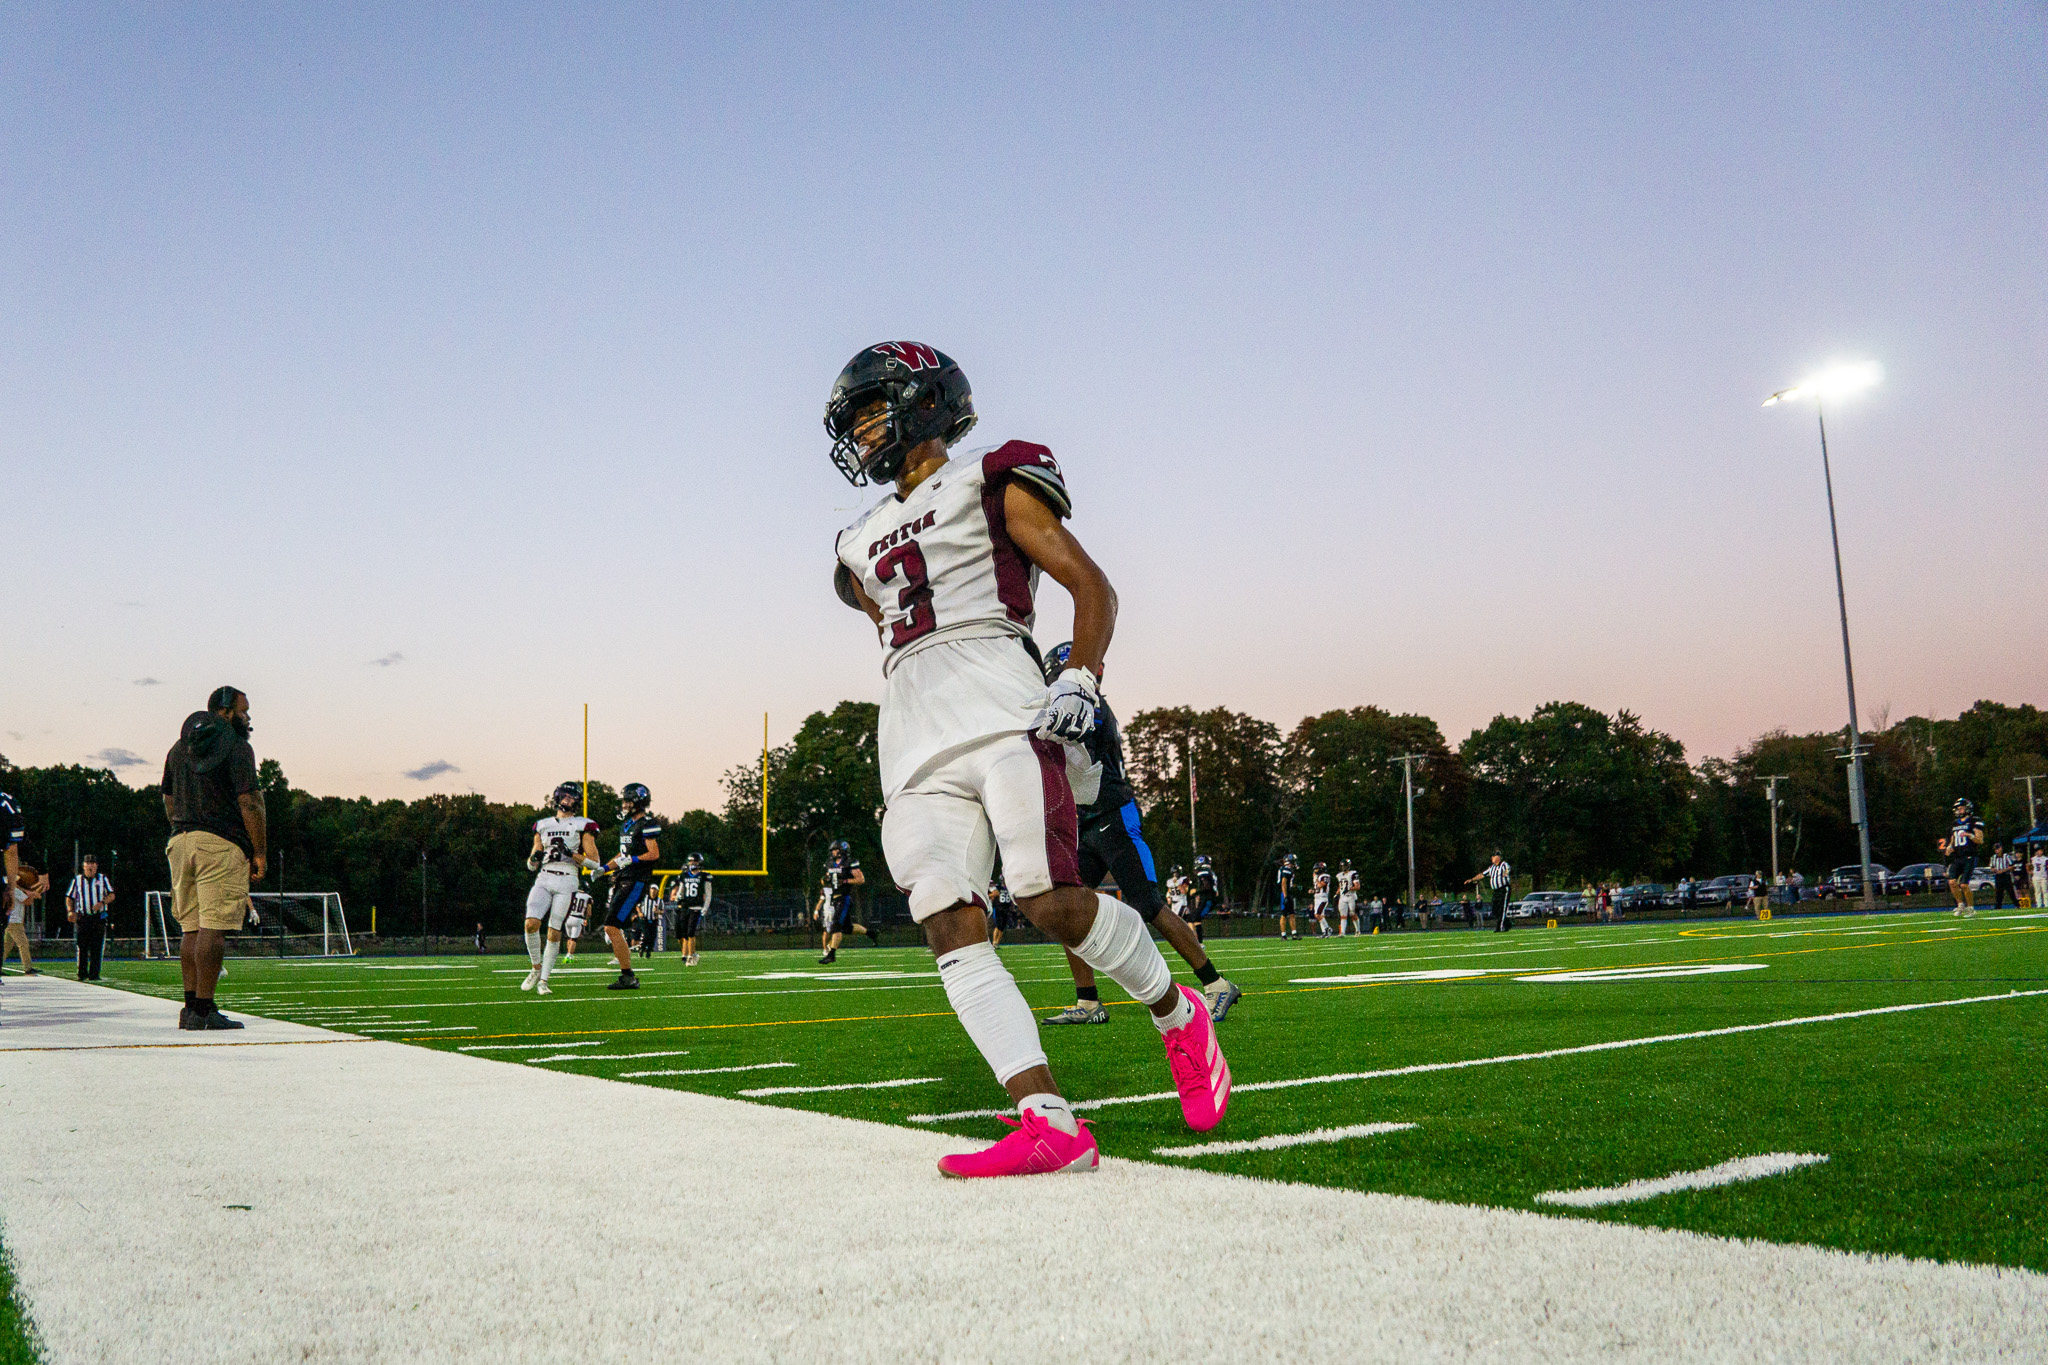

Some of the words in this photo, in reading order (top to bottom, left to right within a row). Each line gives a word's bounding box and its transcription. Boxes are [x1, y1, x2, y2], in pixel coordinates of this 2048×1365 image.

[872, 341, 940, 372] W
[875, 539, 937, 648] 3
[1938, 838, 1947, 850] 2
[1953, 830, 1968, 847] 10
[685, 882, 699, 898] 16
[1761, 910, 1769, 919] 20
